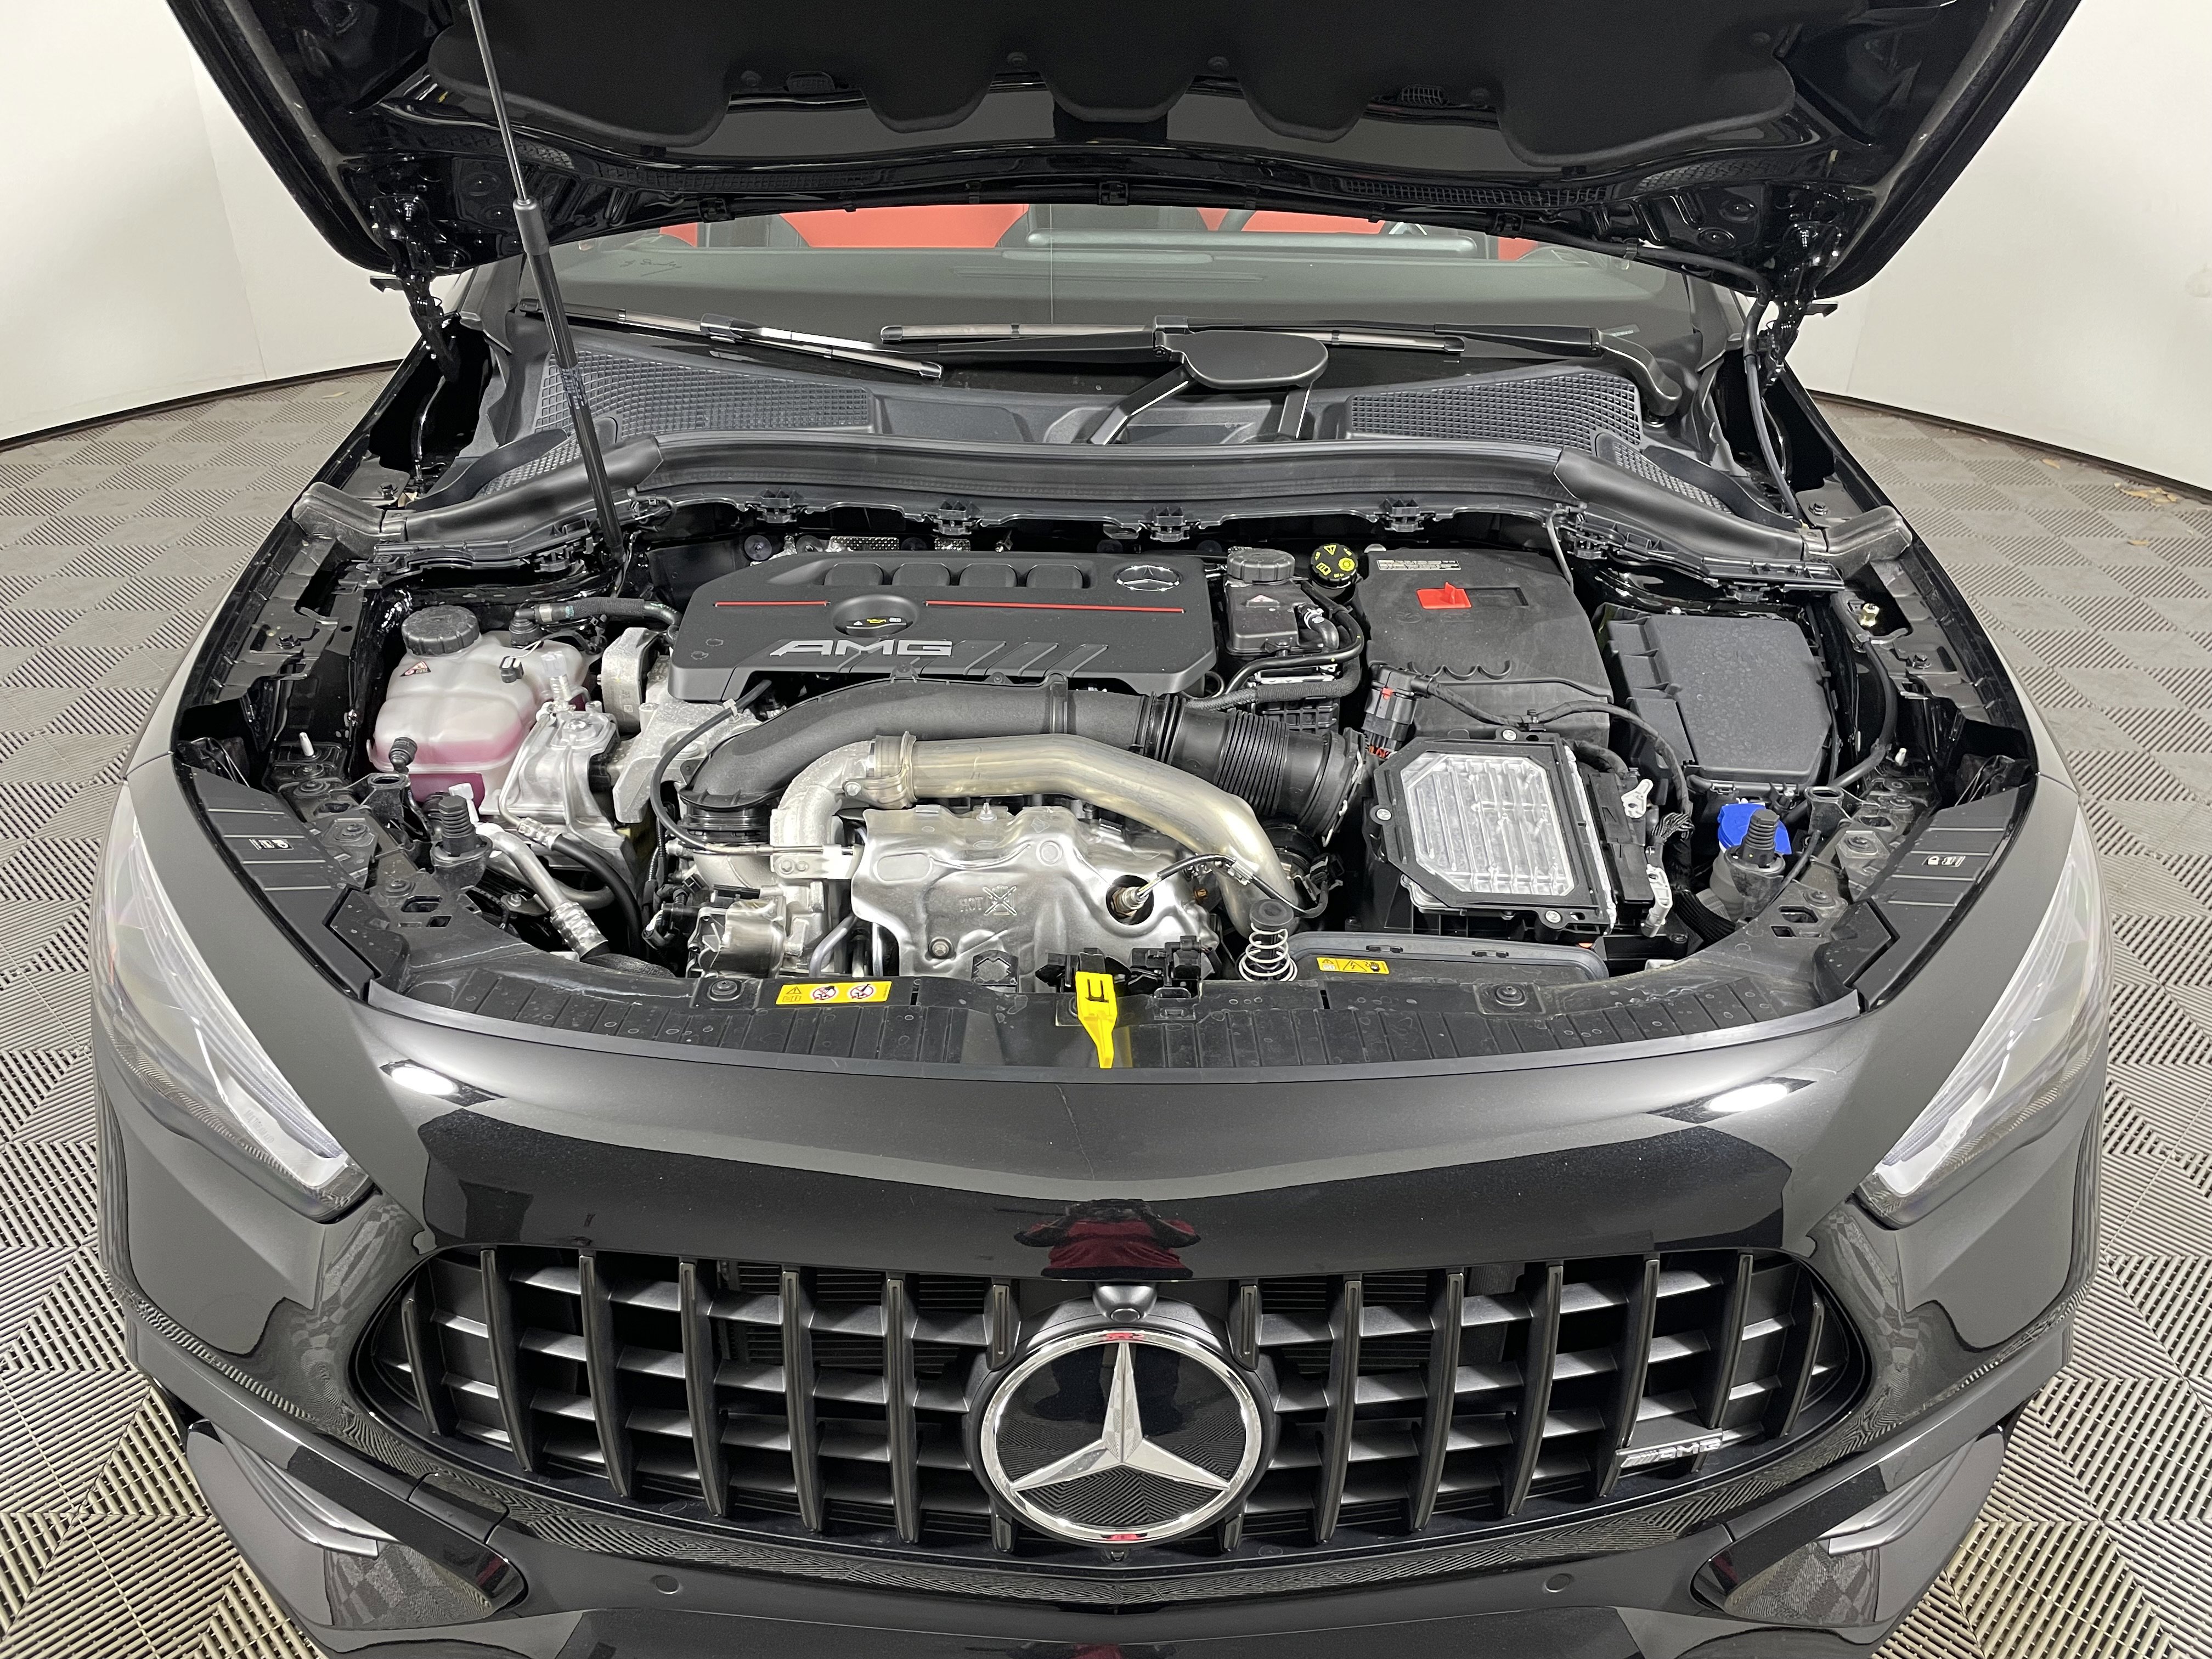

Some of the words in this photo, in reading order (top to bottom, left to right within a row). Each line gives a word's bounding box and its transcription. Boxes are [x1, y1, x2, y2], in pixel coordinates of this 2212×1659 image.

[770, 640, 952, 657] AMG
[960, 896, 984, 912] HOT
[1654, 1438, 1721, 1461] AMG
